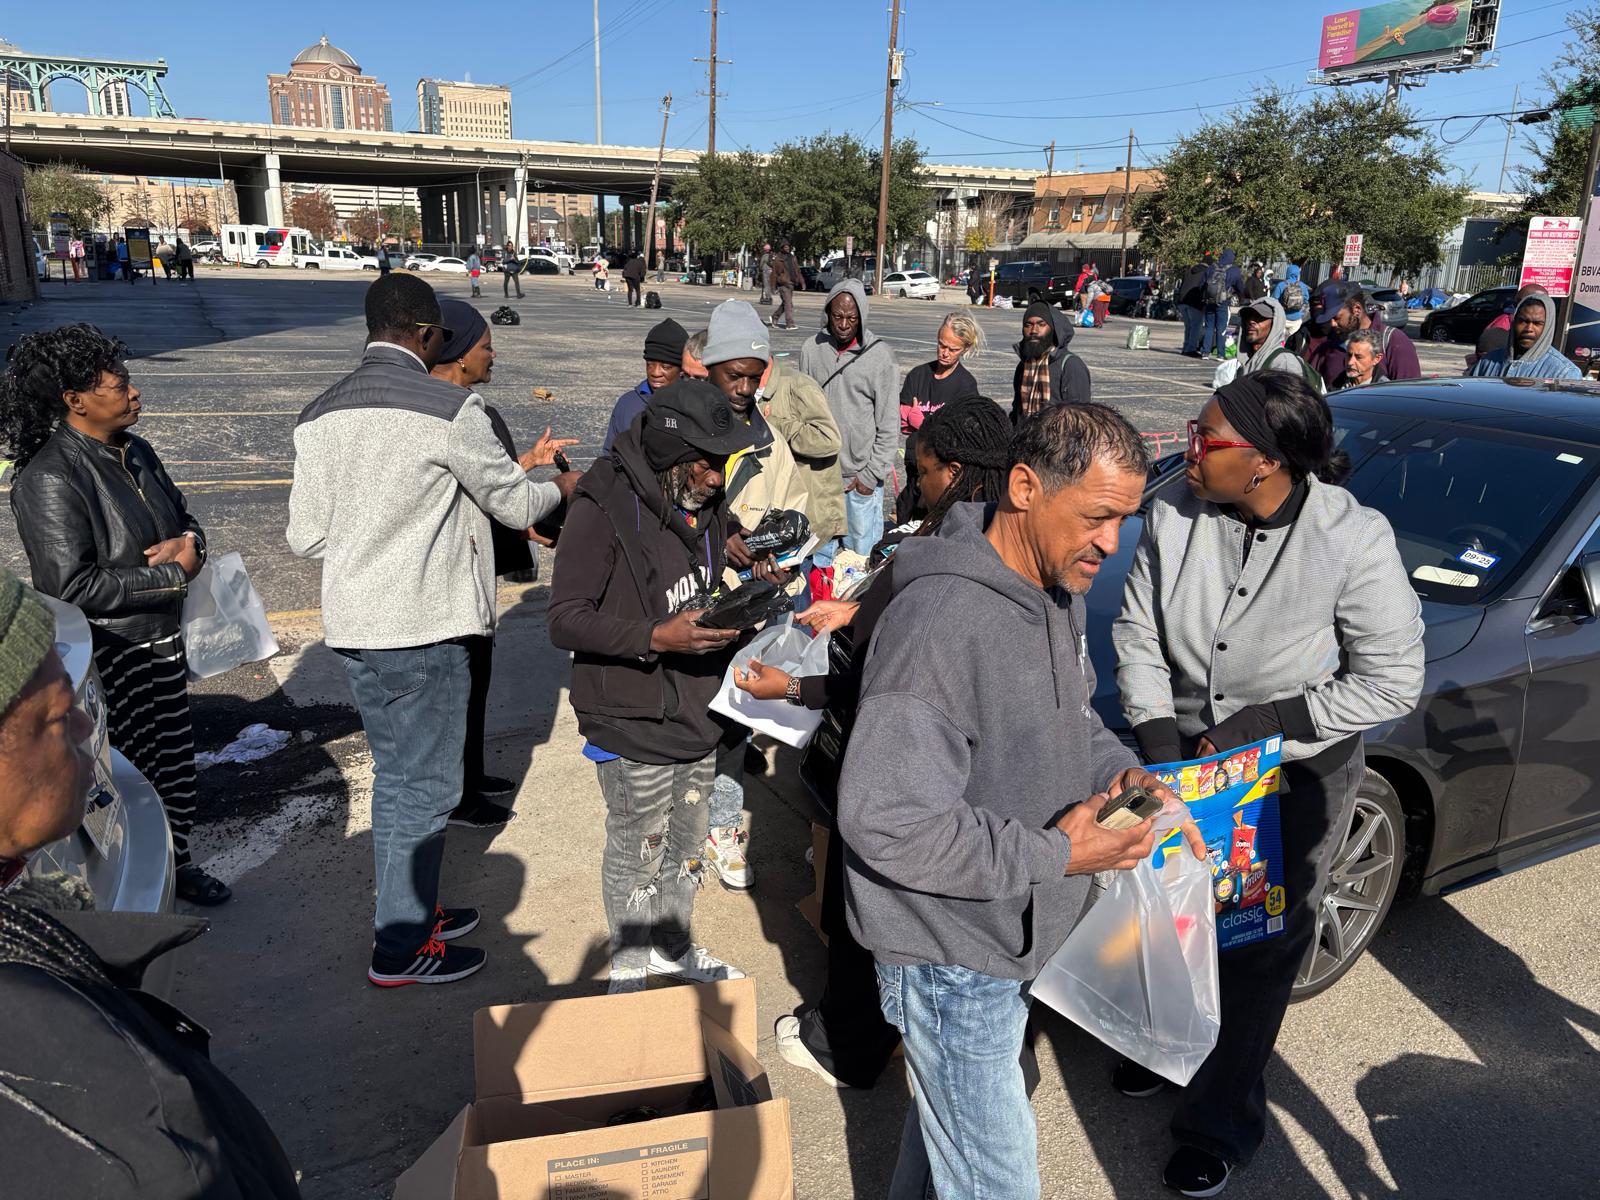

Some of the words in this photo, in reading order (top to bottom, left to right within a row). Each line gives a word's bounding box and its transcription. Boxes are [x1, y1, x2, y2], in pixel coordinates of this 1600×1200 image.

[1350, 236, 1359, 244] NO
[1346, 244, 1361, 252] FREE
[1581, 266, 1600, 276] BBVA
[665, 417, 678, 429] BR
[1269, 889, 1282, 907] 54
[1222, 906, 1264, 929] classic
[650, 1143, 688, 1155] FRAGILE
[554, 1160, 585, 1169] PLACE
[587, 1157, 600, 1166] IN:
[650, 1158, 678, 1168] KITCHEN
[651, 1165, 680, 1175] LAUNDRY
[565, 1172, 592, 1180] MASTER
[651, 1172, 684, 1182] BASEMENT
[565, 1178, 598, 1187] BEDROOM
[651, 1180, 678, 1189] GARAGE
[565, 1185, 589, 1195] FAMILY
[589, 1183, 608, 1191] ROOM
[651, 1188, 669, 1196] ATTIC
